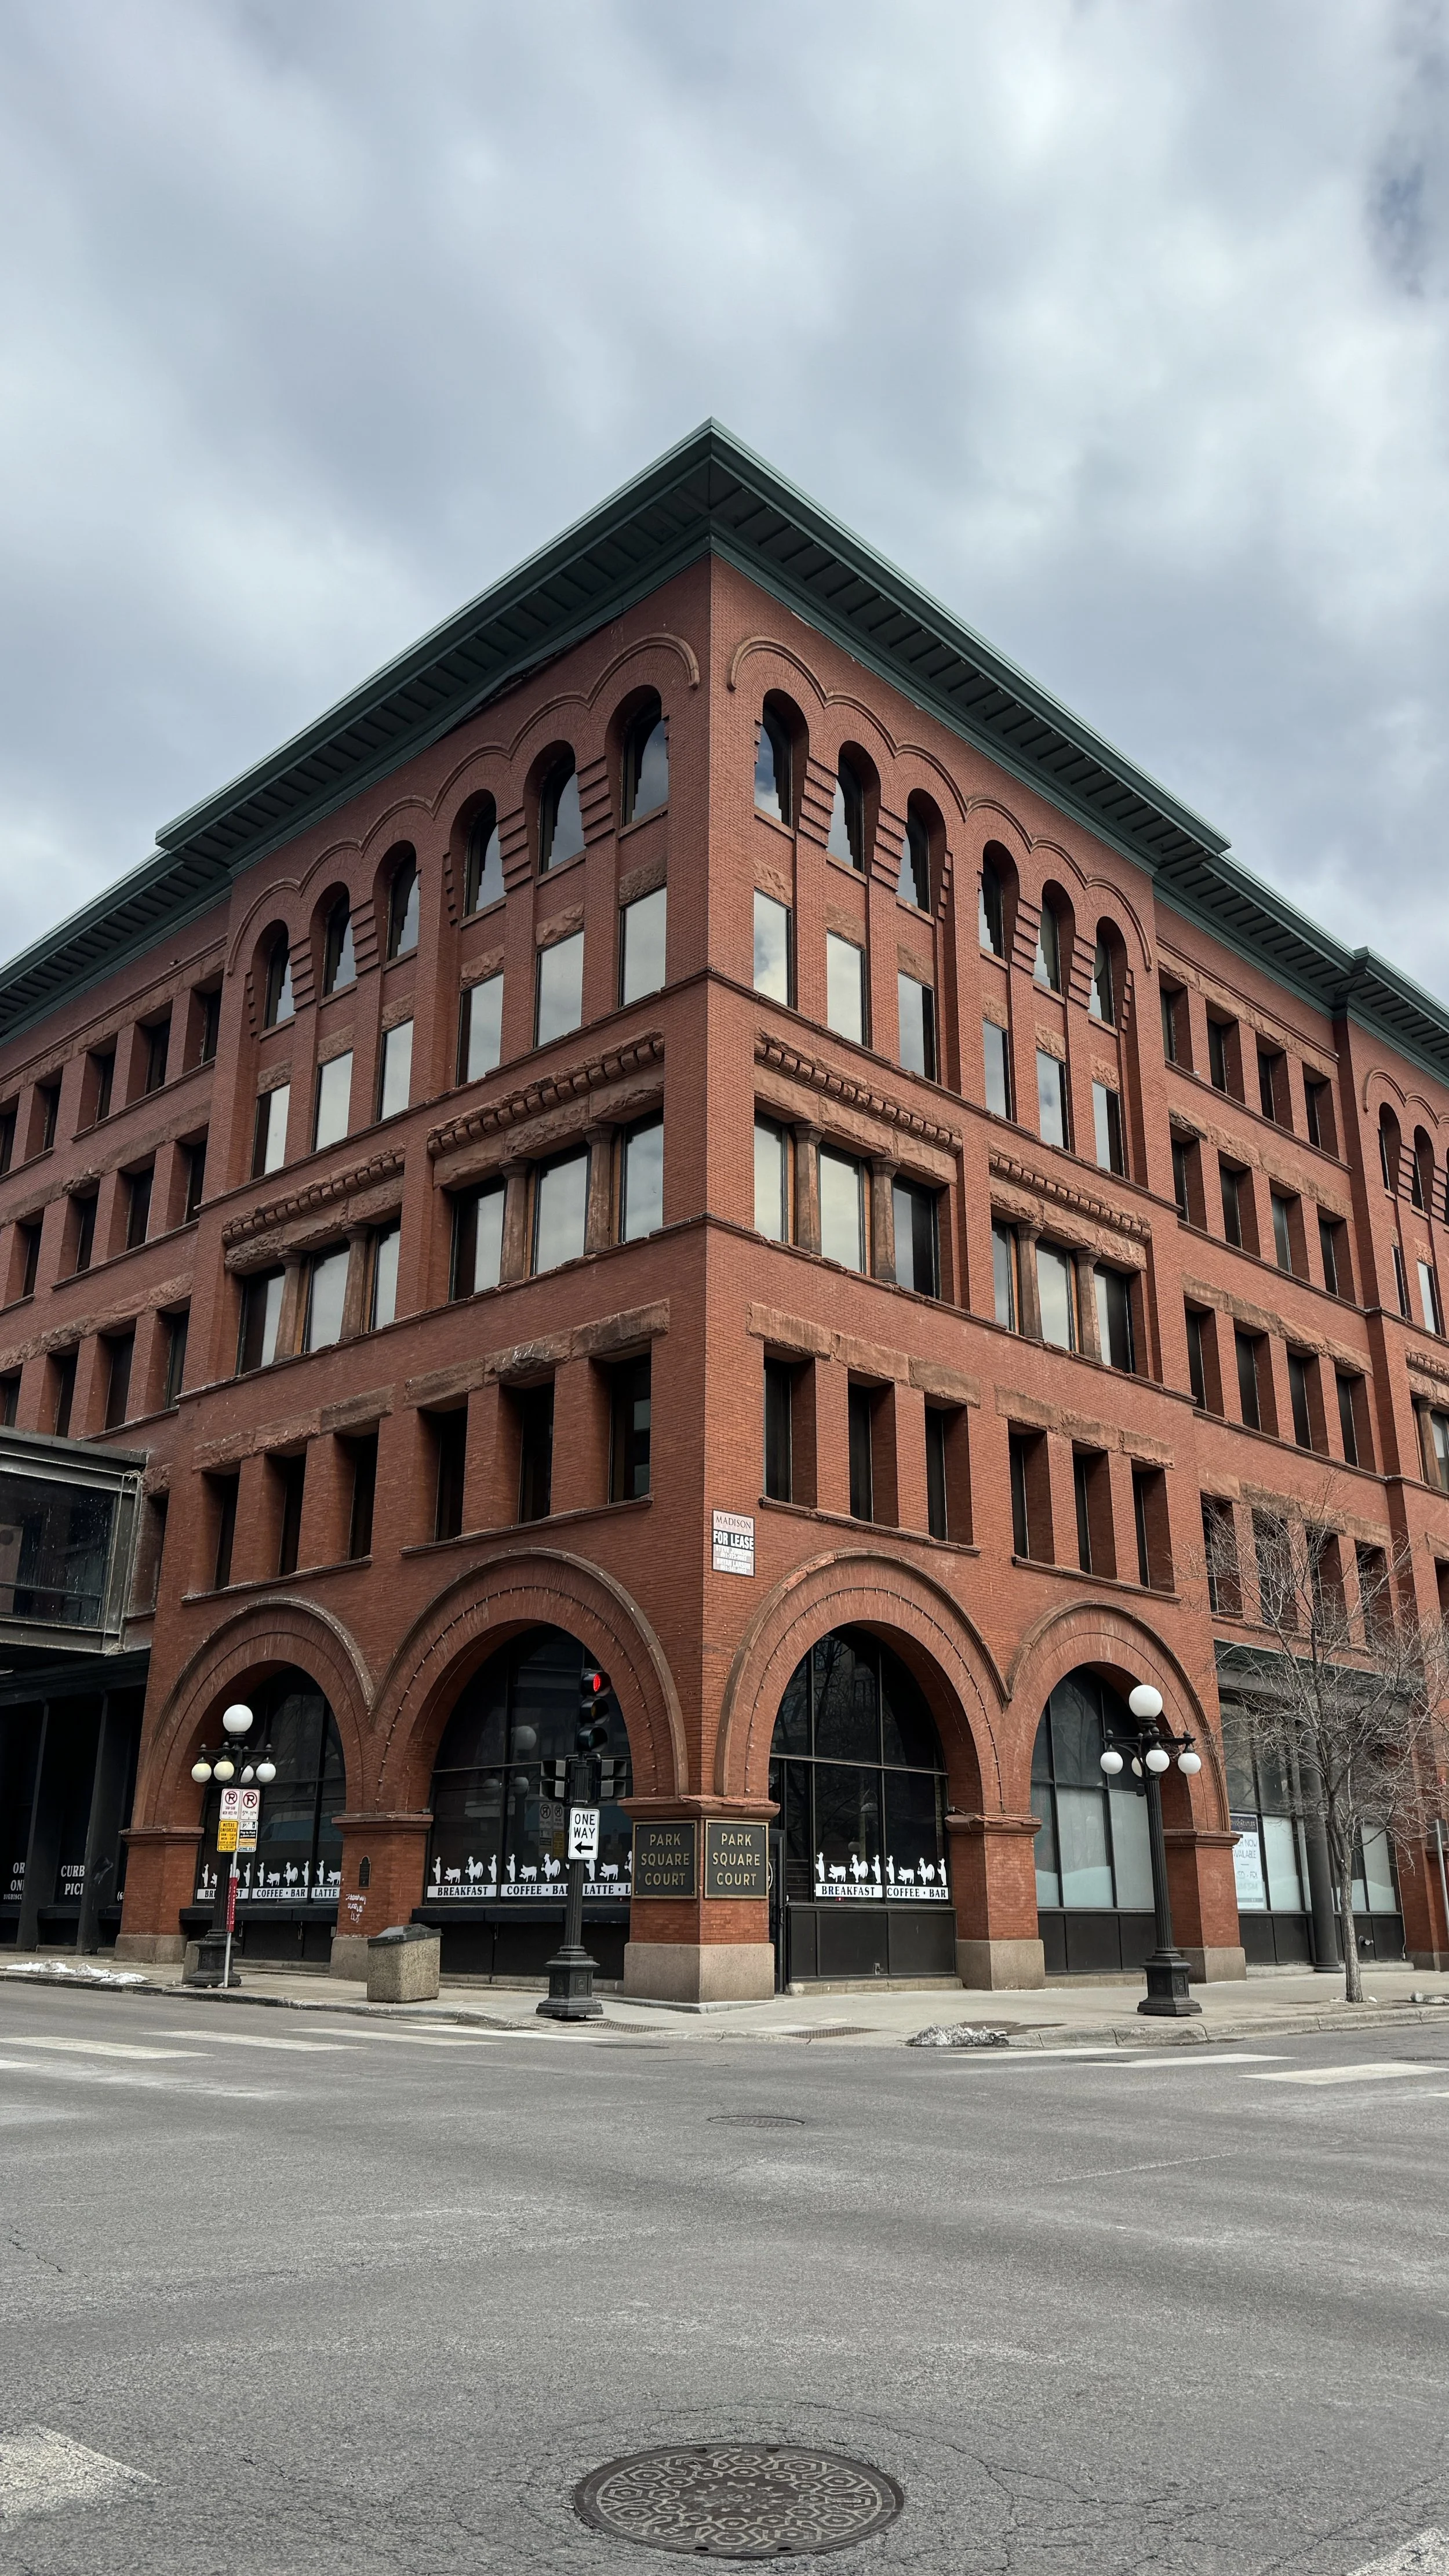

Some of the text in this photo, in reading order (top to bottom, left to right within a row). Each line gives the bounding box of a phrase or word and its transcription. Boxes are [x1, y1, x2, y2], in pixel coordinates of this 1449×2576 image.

[716, 1516, 751, 1529] MADISON
[713, 1530, 754, 1551] FOR LEASE
[575, 1814, 595, 1825] ONE
[574, 1827, 596, 1839] WAY
[650, 1833, 680, 1846] PARK
[722, 1833, 752, 1846] PARK
[641, 1853, 690, 1866] SQUARE
[712, 1852, 760, 1866] SQUARE
[10, 1879, 24, 1891] ON
[645, 1873, 686, 1886] COURT
[716, 1872, 756, 1886] COURT
[257, 1889, 305, 1897] COFFEE BAR
[314, 1889, 337, 1897] LATTE
[437, 1886, 489, 1896] BREAKFAST
[507, 1885, 542, 1895] COFFEE
[584, 1884, 614, 1894] LATTE
[822, 1886, 875, 1896] BREAKFAST
[887, 1887, 946, 1898] COFFEE BAR
